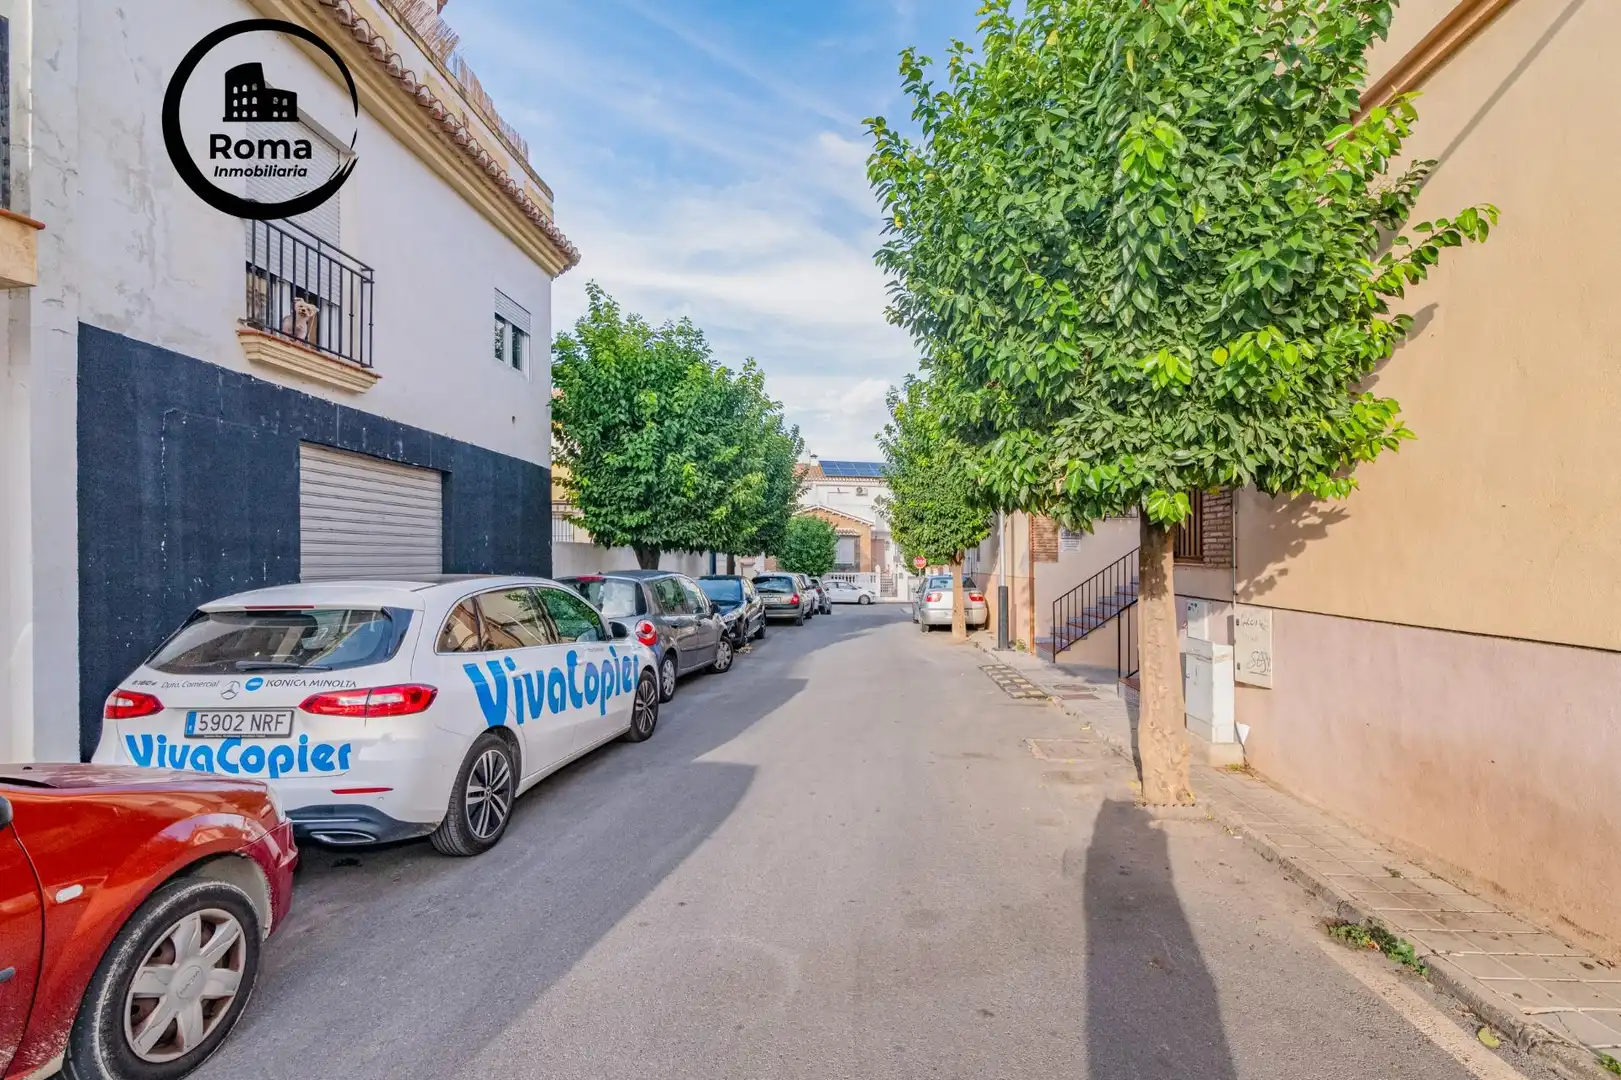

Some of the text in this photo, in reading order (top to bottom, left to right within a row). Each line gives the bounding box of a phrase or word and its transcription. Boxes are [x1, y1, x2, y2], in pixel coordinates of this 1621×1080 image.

[181, 679, 219, 688] Comercial
[266, 679, 357, 688] KONICA MINOLTA
[462, 646, 639, 727] VivaCopier
[198, 714, 287, 732] 5902 NRF
[125, 734, 352, 778] VivaCopier
